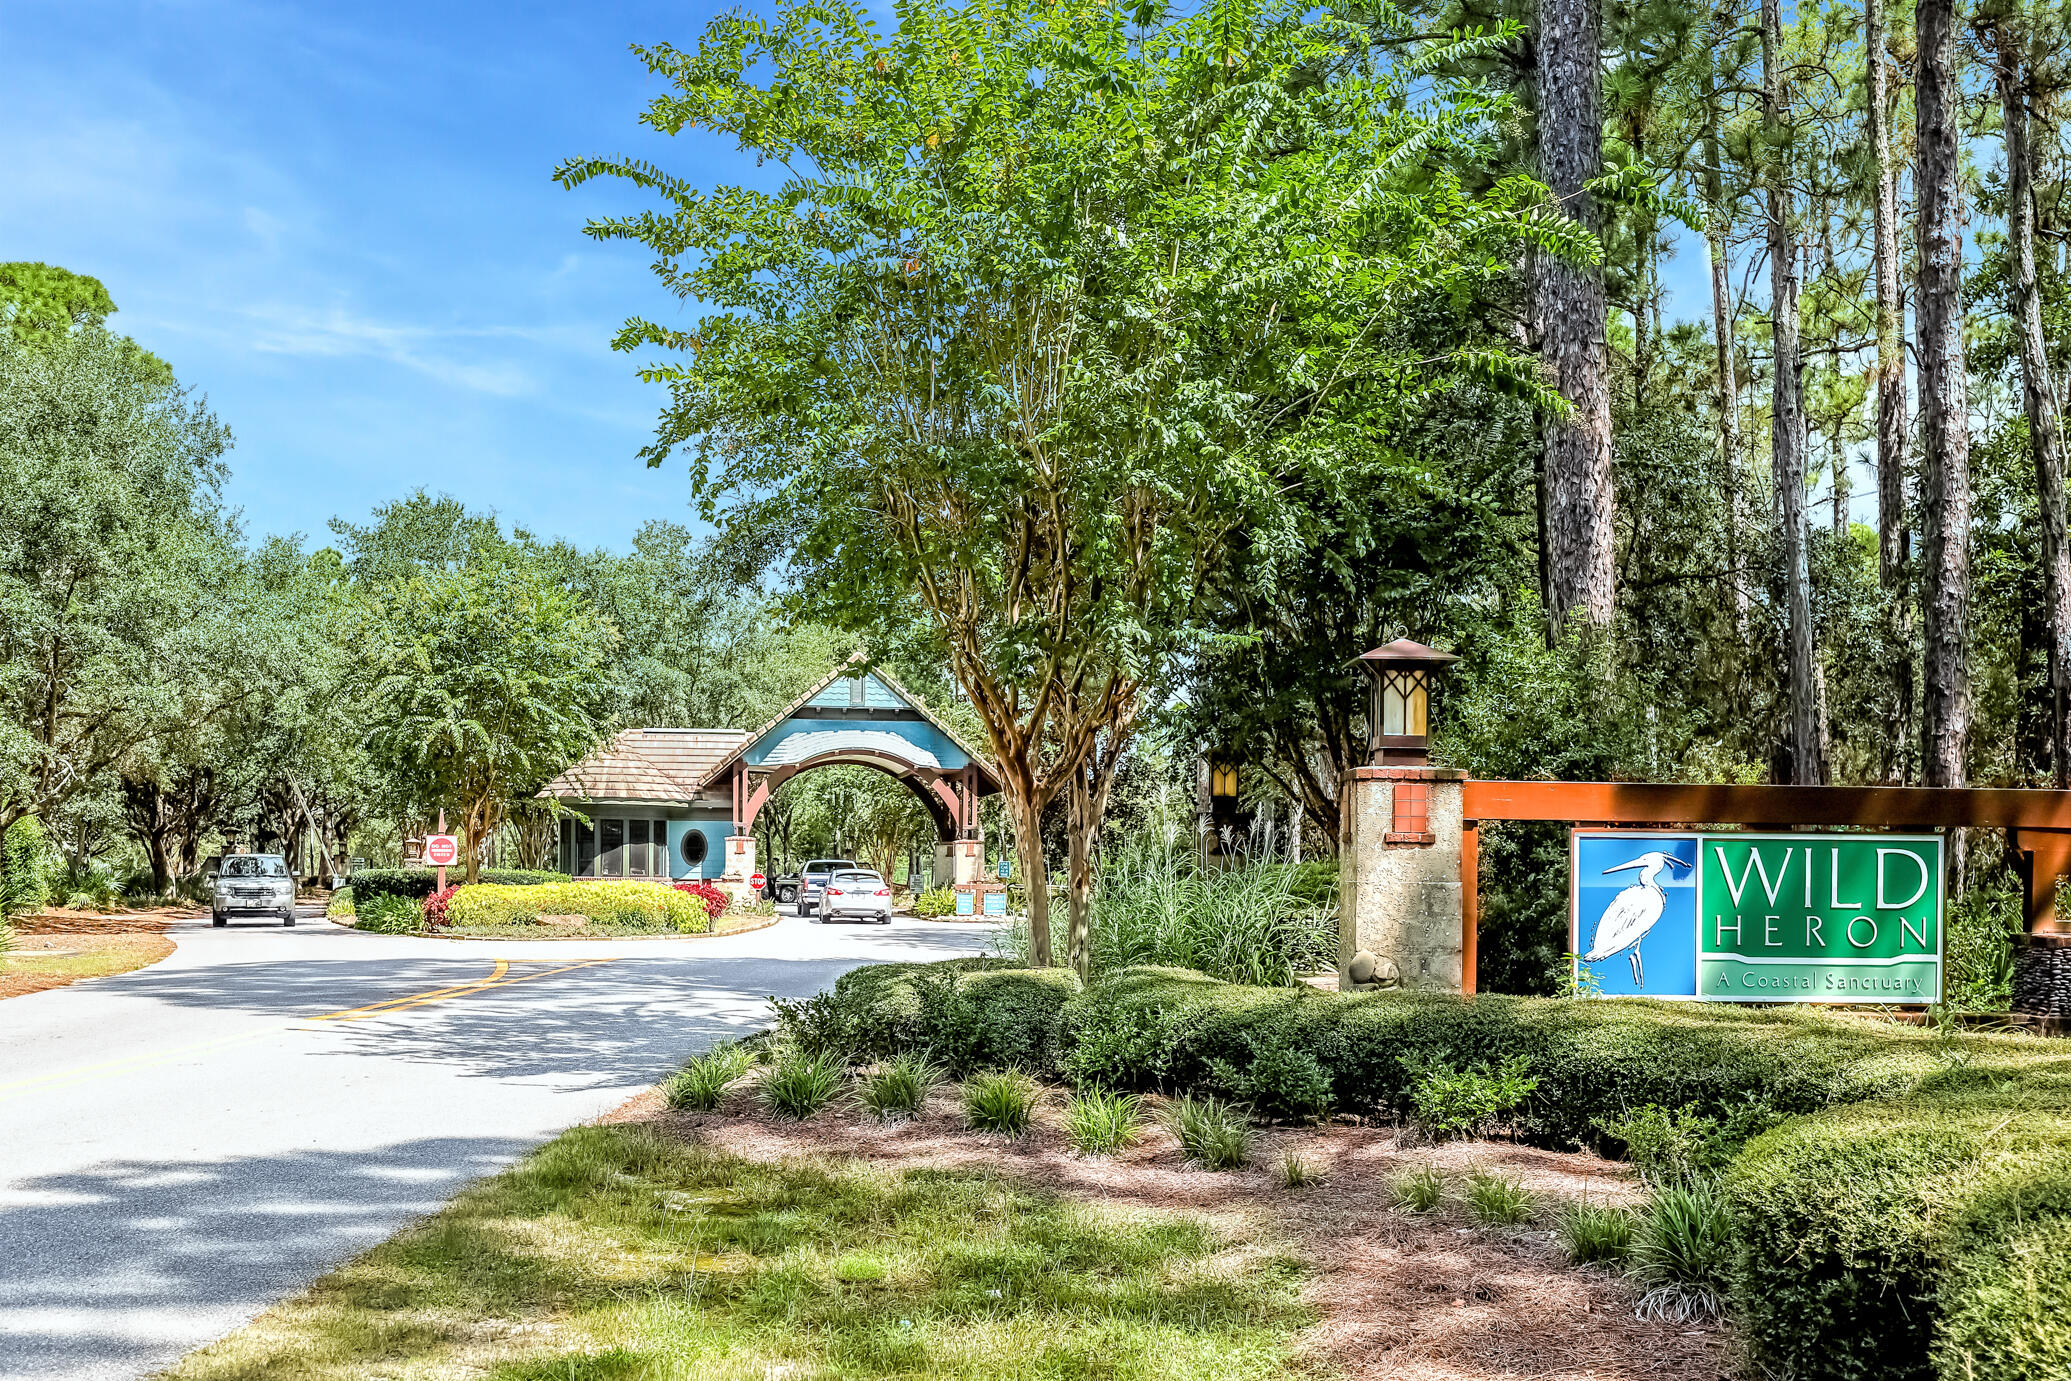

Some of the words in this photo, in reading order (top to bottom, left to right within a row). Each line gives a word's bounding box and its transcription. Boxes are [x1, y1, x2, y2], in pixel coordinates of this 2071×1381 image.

[750, 877, 766, 886] STOP
[1714, 846, 1928, 909] WILD
[1715, 914, 1927, 948] HERON
[1716, 971, 1730, 988] A
[1741, 971, 1817, 989] Coastal
[1825, 972, 1923, 994] Sanctuary
